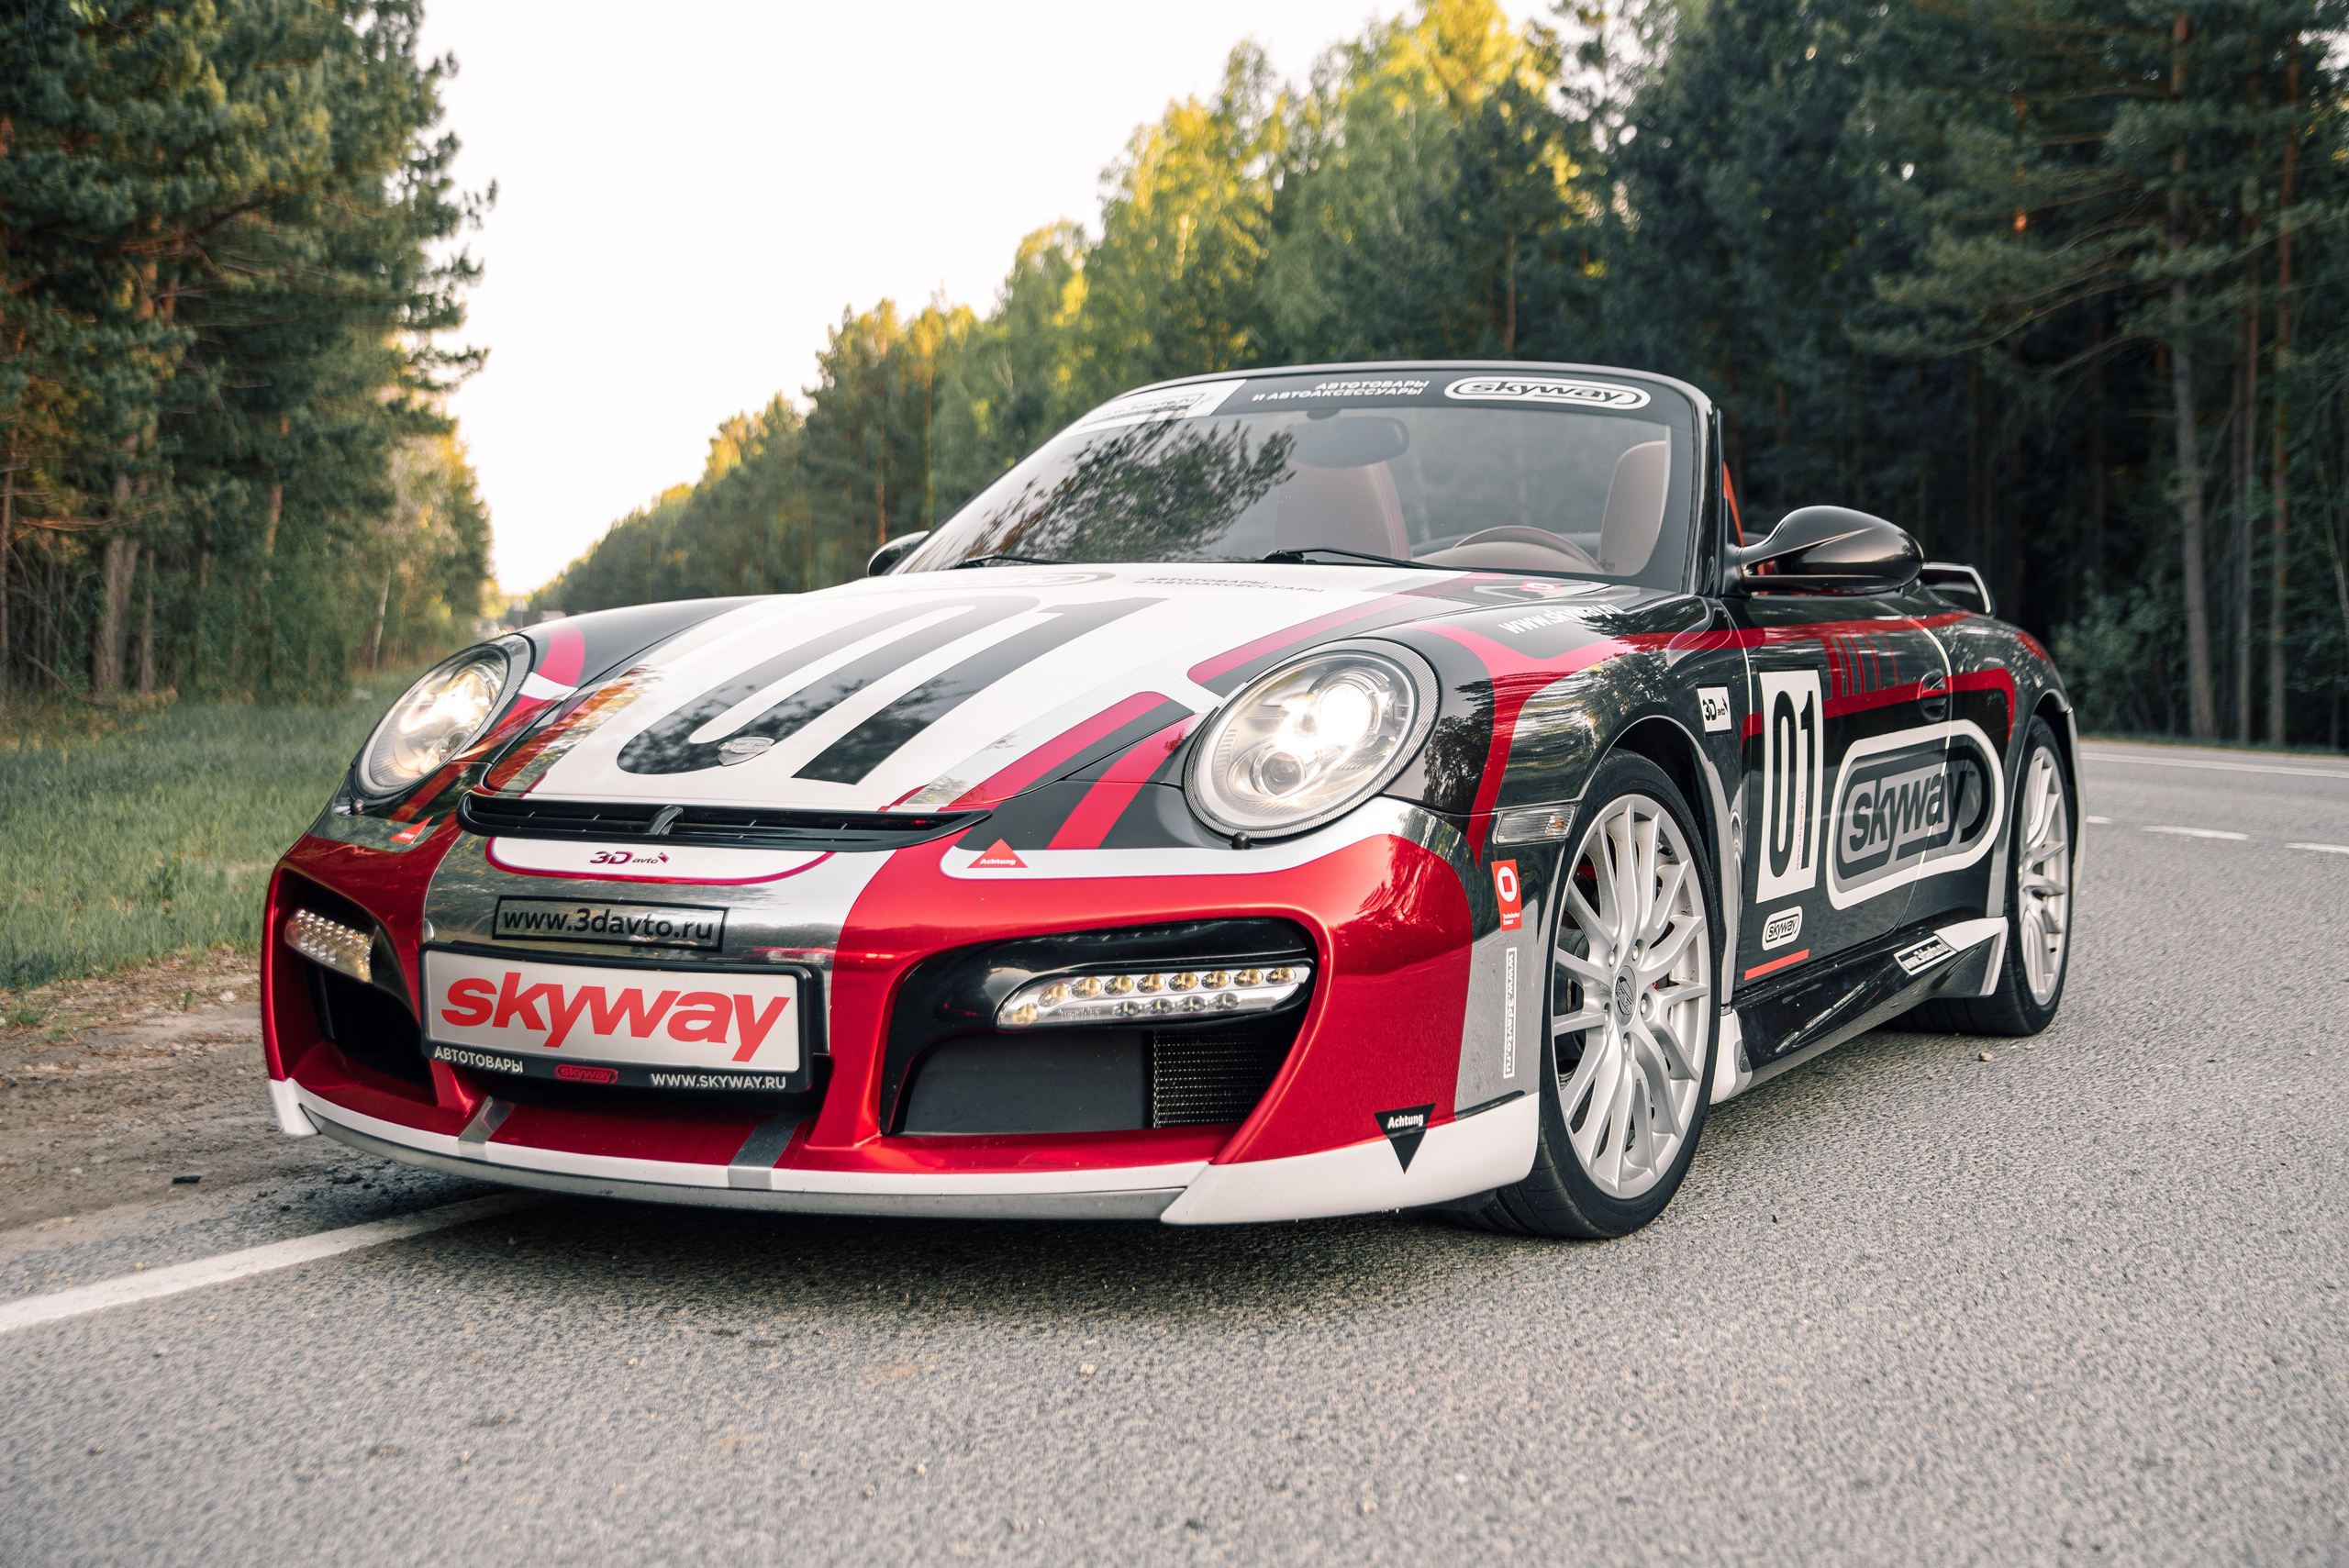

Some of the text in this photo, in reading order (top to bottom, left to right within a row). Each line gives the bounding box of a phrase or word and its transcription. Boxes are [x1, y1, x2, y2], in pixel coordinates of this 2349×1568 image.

[1267, 388, 1424, 401] АВТОАКСЕССУАРЫ
[1315, 380, 1430, 391] АВТОТОВАРЫ
[1469, 381, 1623, 403] skyway
[617, 595, 1170, 785] 01
[1769, 690, 1816, 878] 01
[1849, 770, 1967, 855] skyway
[590, 851, 633, 865] 3D
[505, 907, 714, 940] www.3davto.ru
[1768, 918, 1798, 938] skyway
[440, 972, 791, 1062] skyway
[434, 1046, 524, 1073] АВТОТОВАРЫ
[560, 1065, 614, 1081] skyway
[651, 1073, 786, 1091] WWW.SKYWAY.RU
[1386, 1113, 1424, 1129] Achtung
